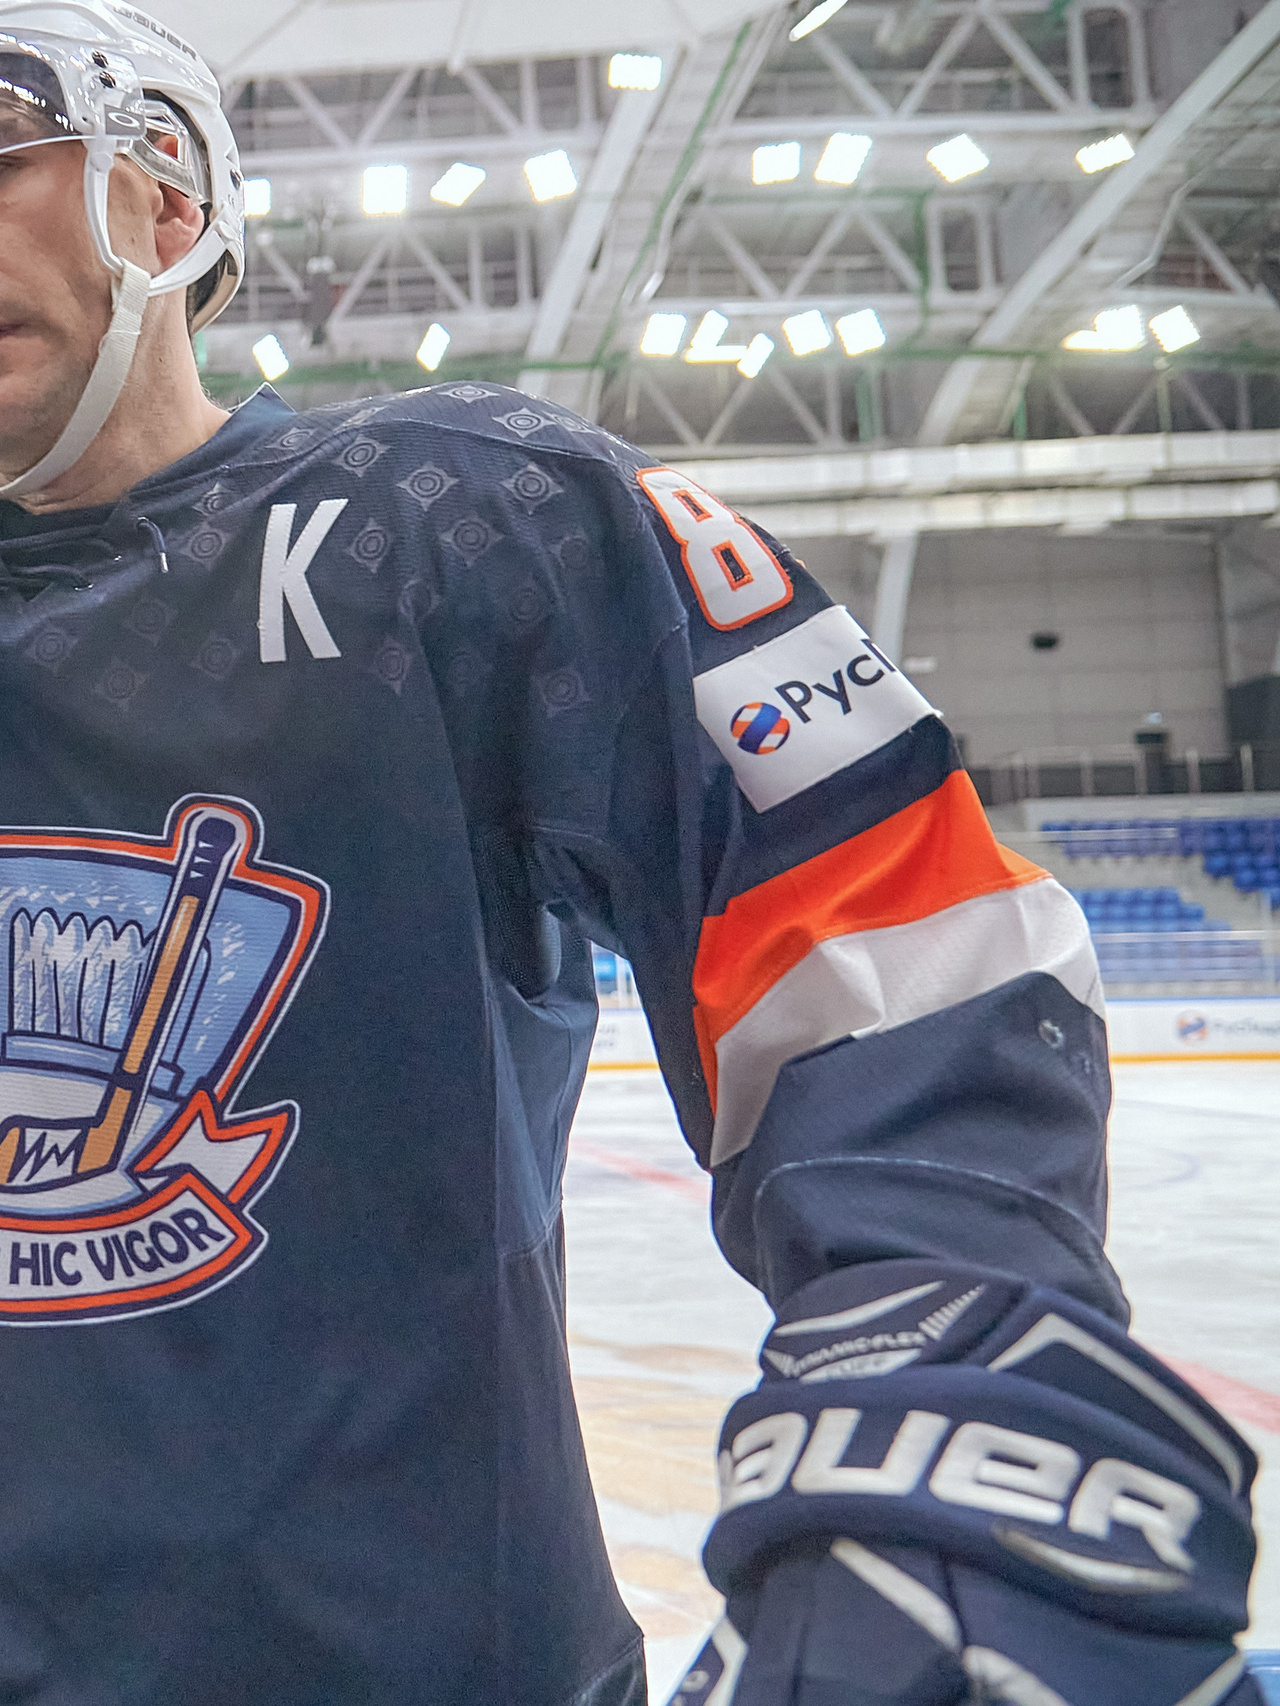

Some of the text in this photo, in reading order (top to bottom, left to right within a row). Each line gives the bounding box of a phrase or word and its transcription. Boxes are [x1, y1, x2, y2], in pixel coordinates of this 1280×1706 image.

[9, 1240, 83, 1287] HIC
[86, 1208, 226, 1281] VIGOR
[718, 1408, 1197, 1573] AUER
